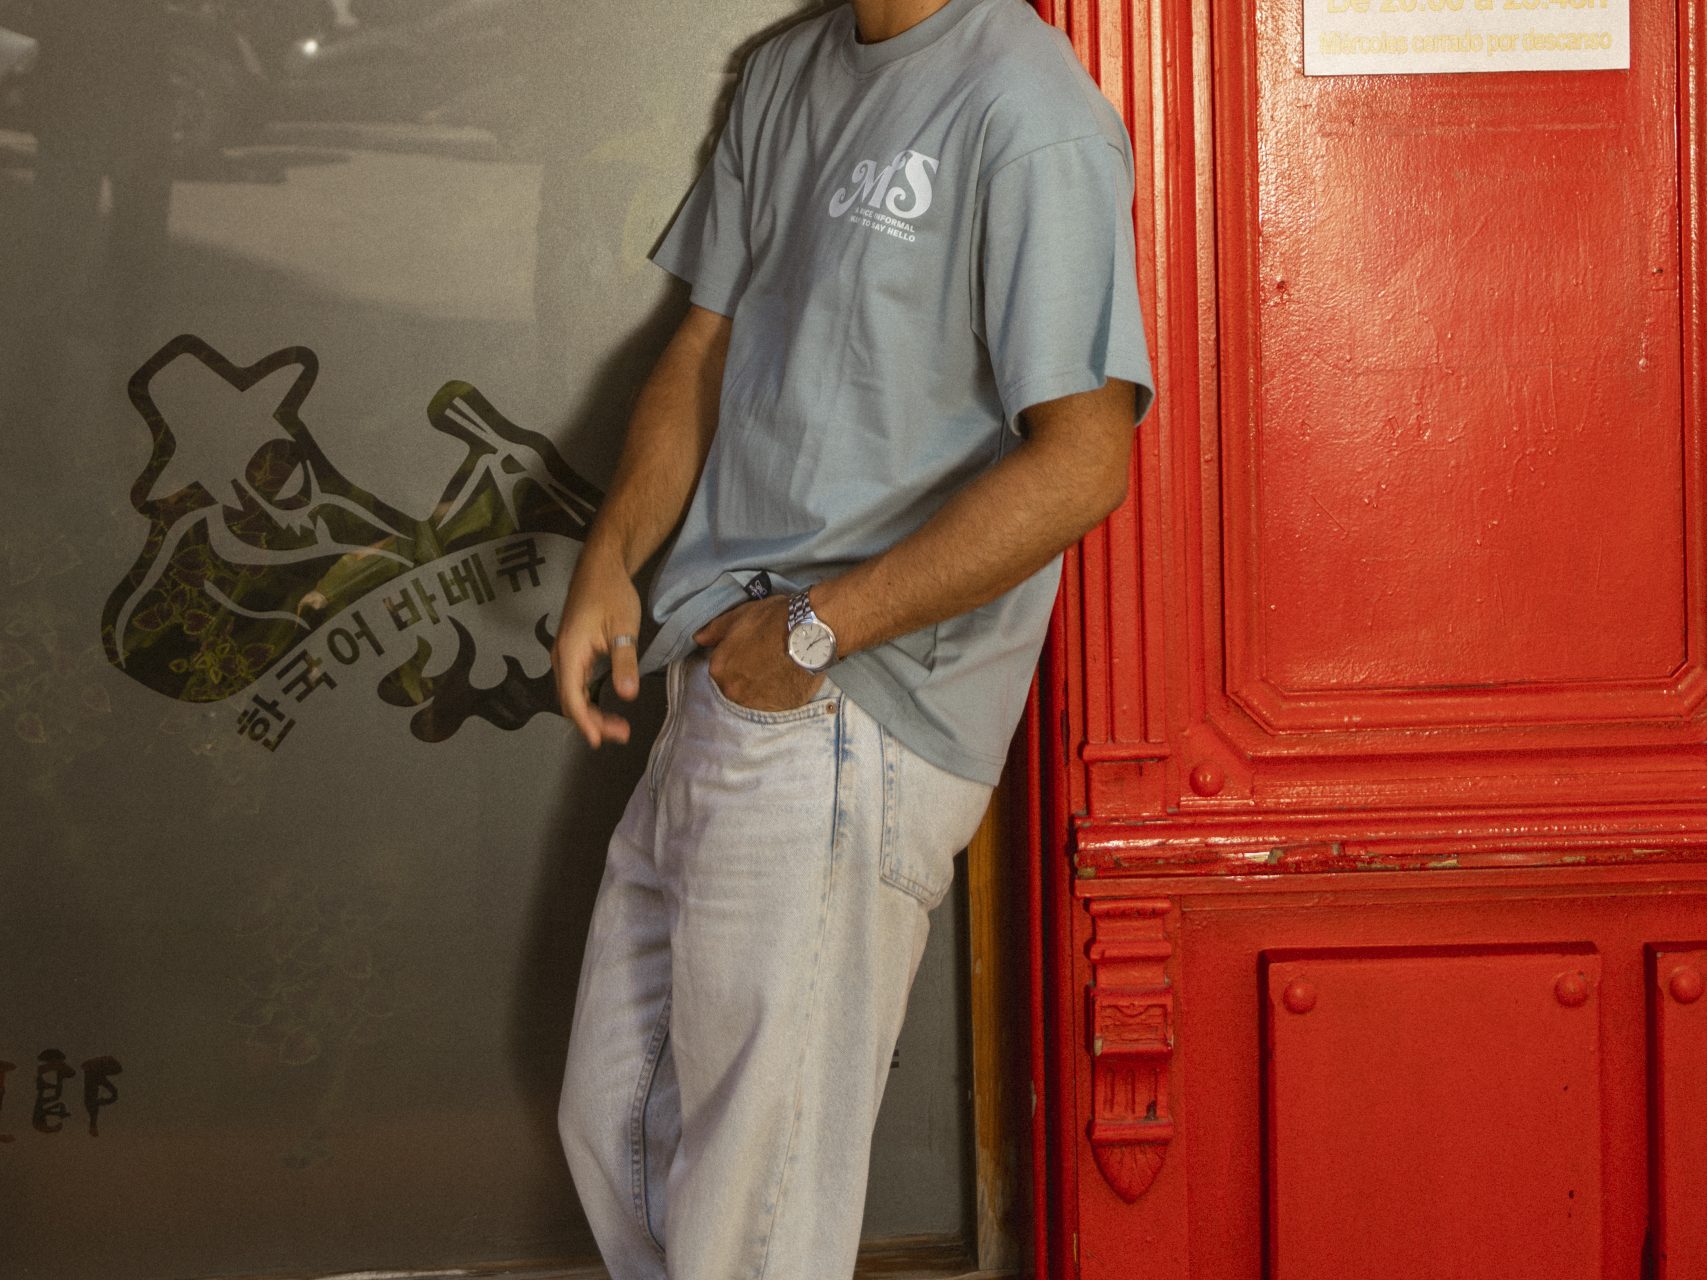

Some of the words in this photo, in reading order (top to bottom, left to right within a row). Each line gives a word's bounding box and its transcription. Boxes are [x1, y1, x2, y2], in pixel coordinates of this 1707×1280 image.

[1319, 30, 1408, 56] Miércoles
[1411, 28, 1484, 53] cerrado
[1487, 31, 1520, 57] por
[1522, 27, 1612, 52] descanso
[862, 218, 871, 227] TO
[871, 222, 886, 232] SAY
[887, 227, 916, 243] HELLO
[874, 213, 915, 233] INFORMAL
[236, 610, 386, 753] 한국어
[382, 537, 546, 632] 바베큐
